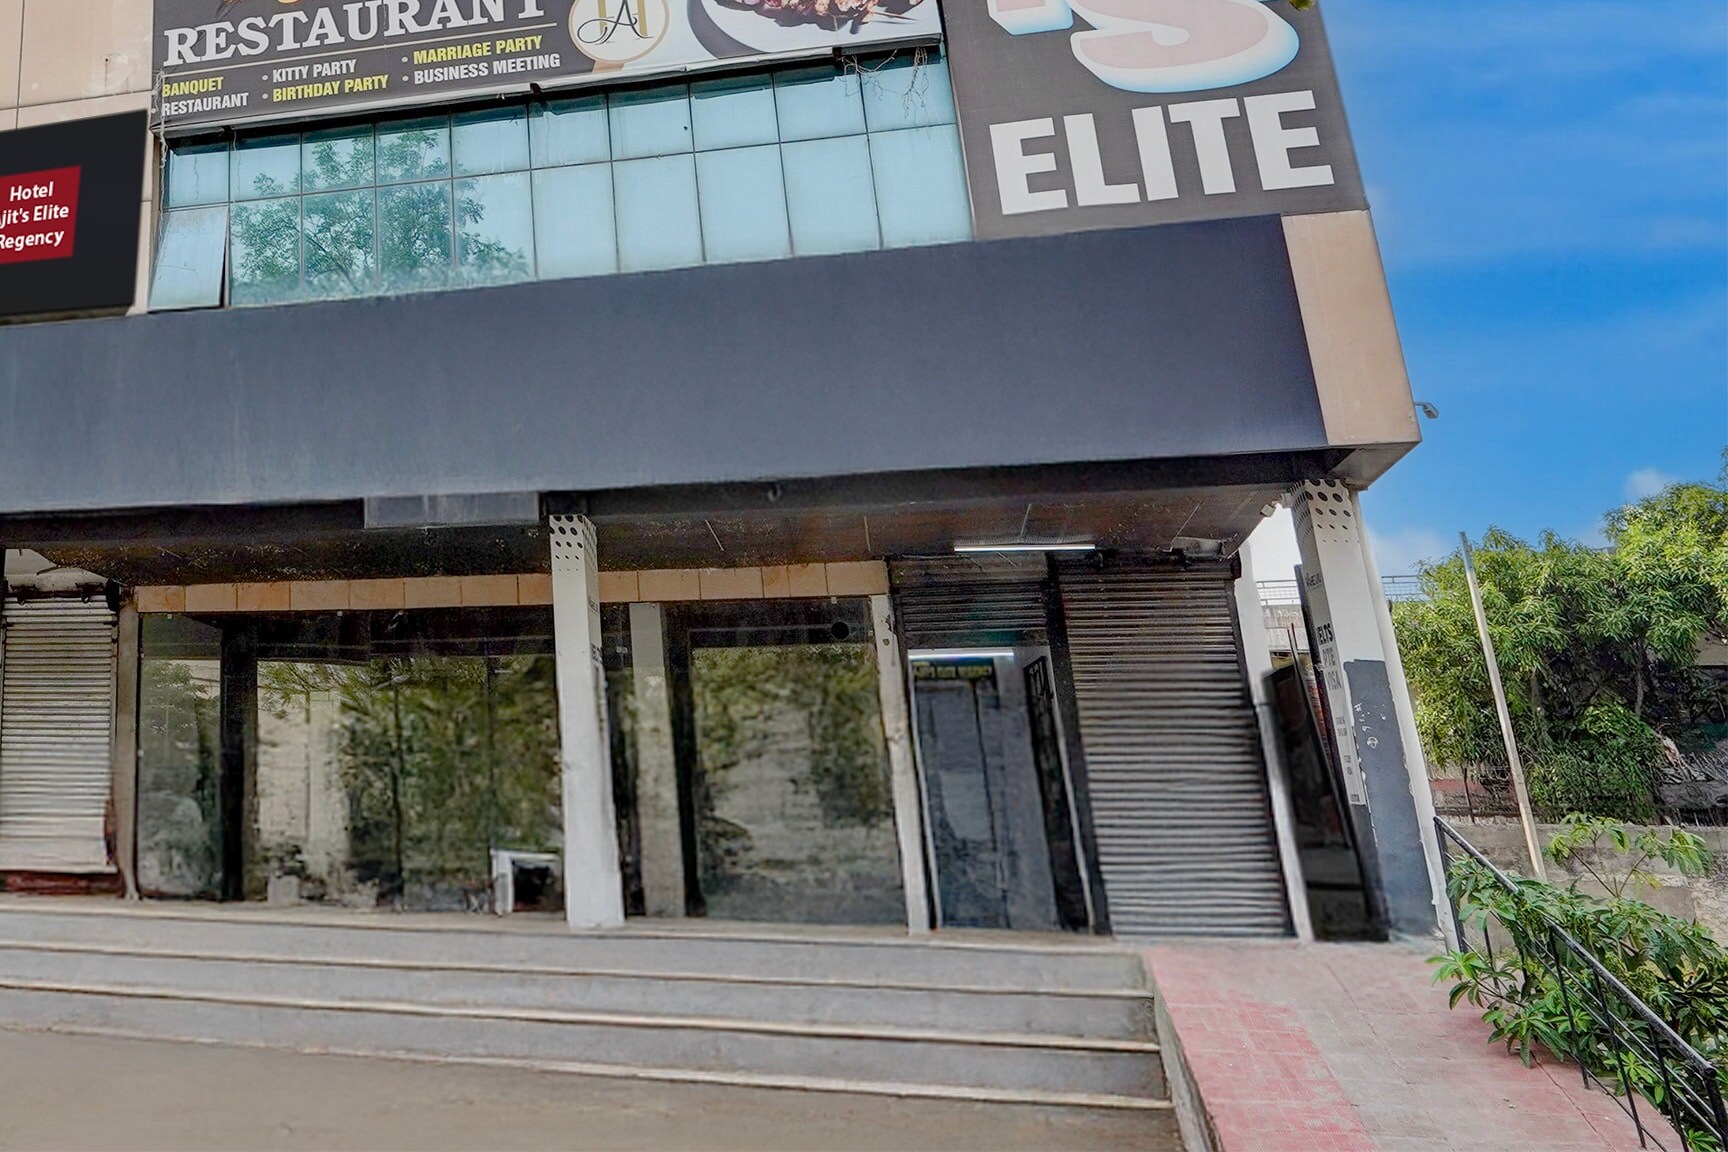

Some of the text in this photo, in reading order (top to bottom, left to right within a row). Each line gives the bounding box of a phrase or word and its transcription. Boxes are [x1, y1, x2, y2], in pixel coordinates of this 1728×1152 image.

[413, 35, 543, 65] MARRIAGE PARTY
[273, 59, 357, 83] KITTY PARTY
[414, 52, 561, 85] BUSINESS MEETING
[162, 76, 224, 98] BANQUET
[272, 74, 390, 103] BIRTHDAY PARTY
[161, 92, 249, 117] RESTAURANT
[989, 89, 1335, 216] ELITE
[9, 181, 54, 202] Hotel
[33, 203, 70, 222] Elite
